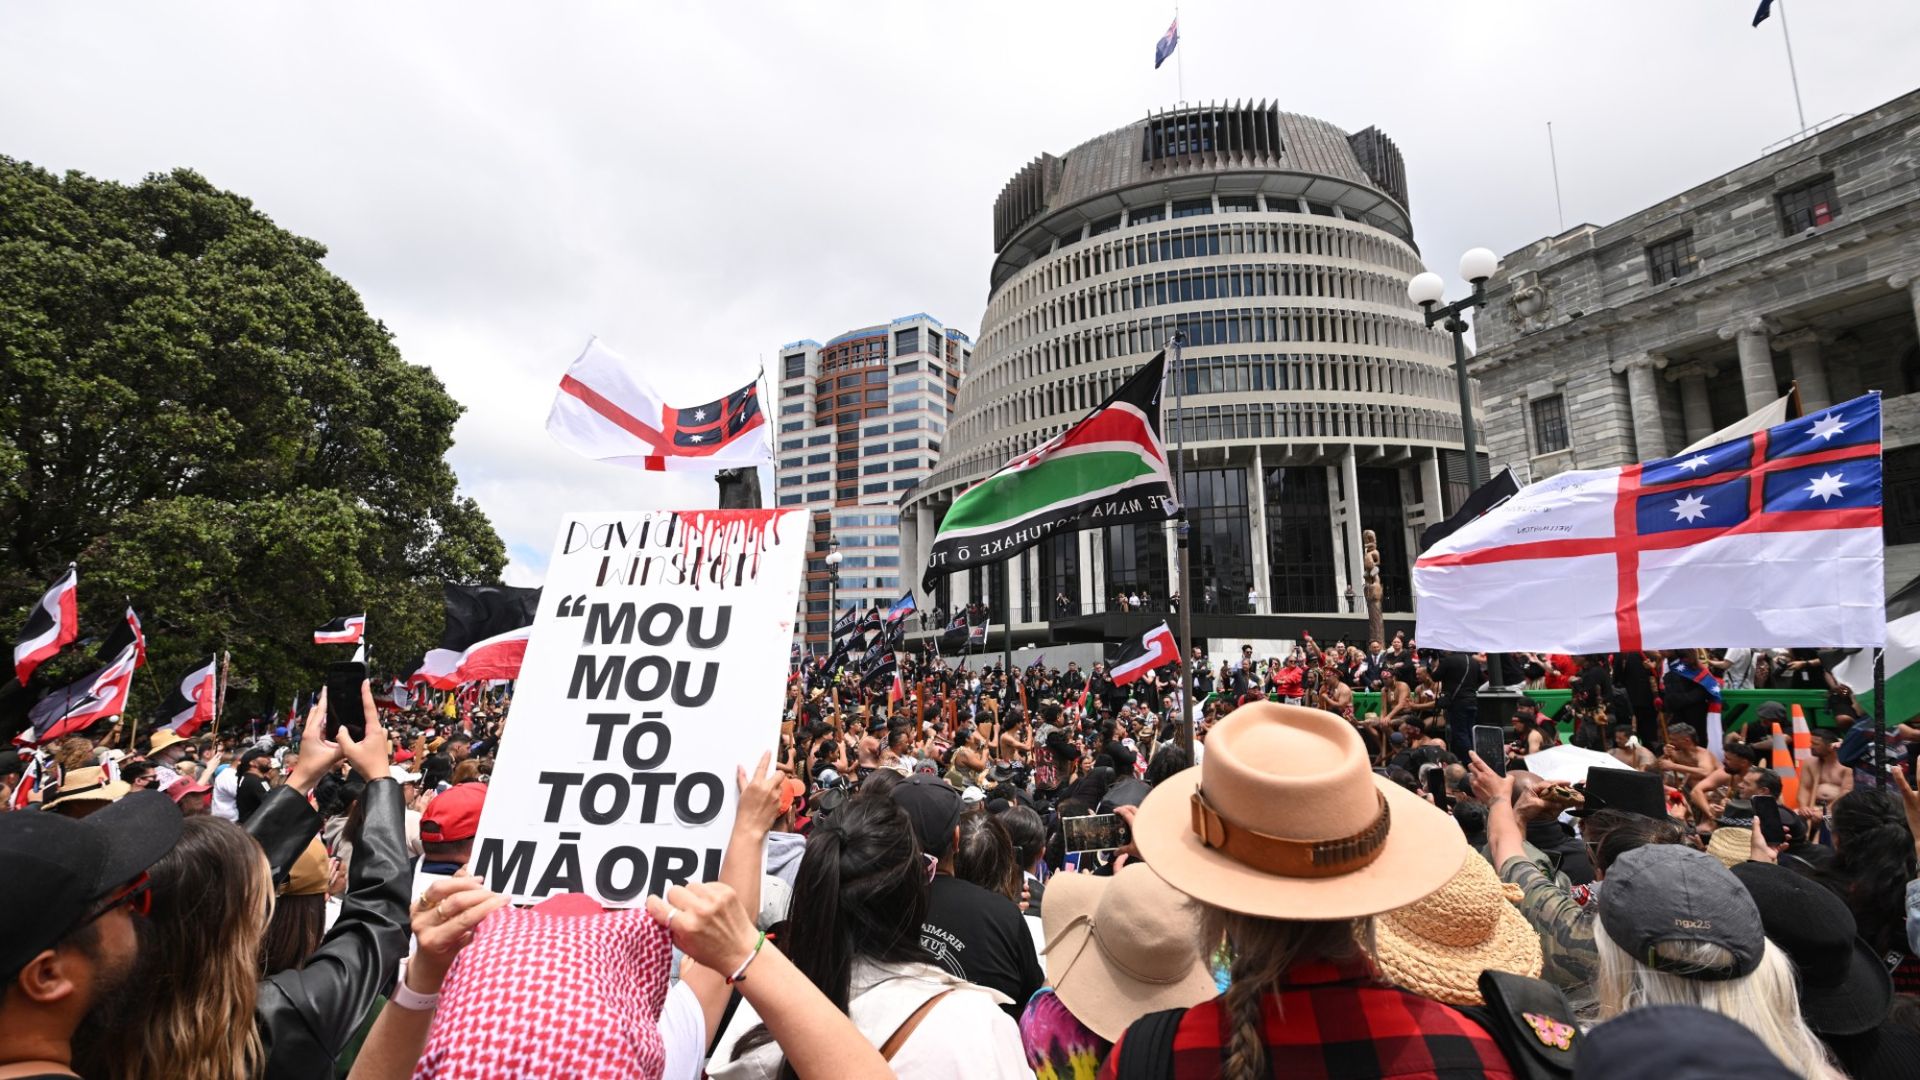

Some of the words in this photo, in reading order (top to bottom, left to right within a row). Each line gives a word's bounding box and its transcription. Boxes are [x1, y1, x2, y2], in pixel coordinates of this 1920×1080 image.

[563, 513, 678, 554] David
[567, 655, 720, 708] MOU
[586, 711, 671, 770] TŌ
[538, 771, 725, 825] TOTO
[474, 832, 722, 902] MĀORI
[921, 923, 965, 951] AIMARIE
